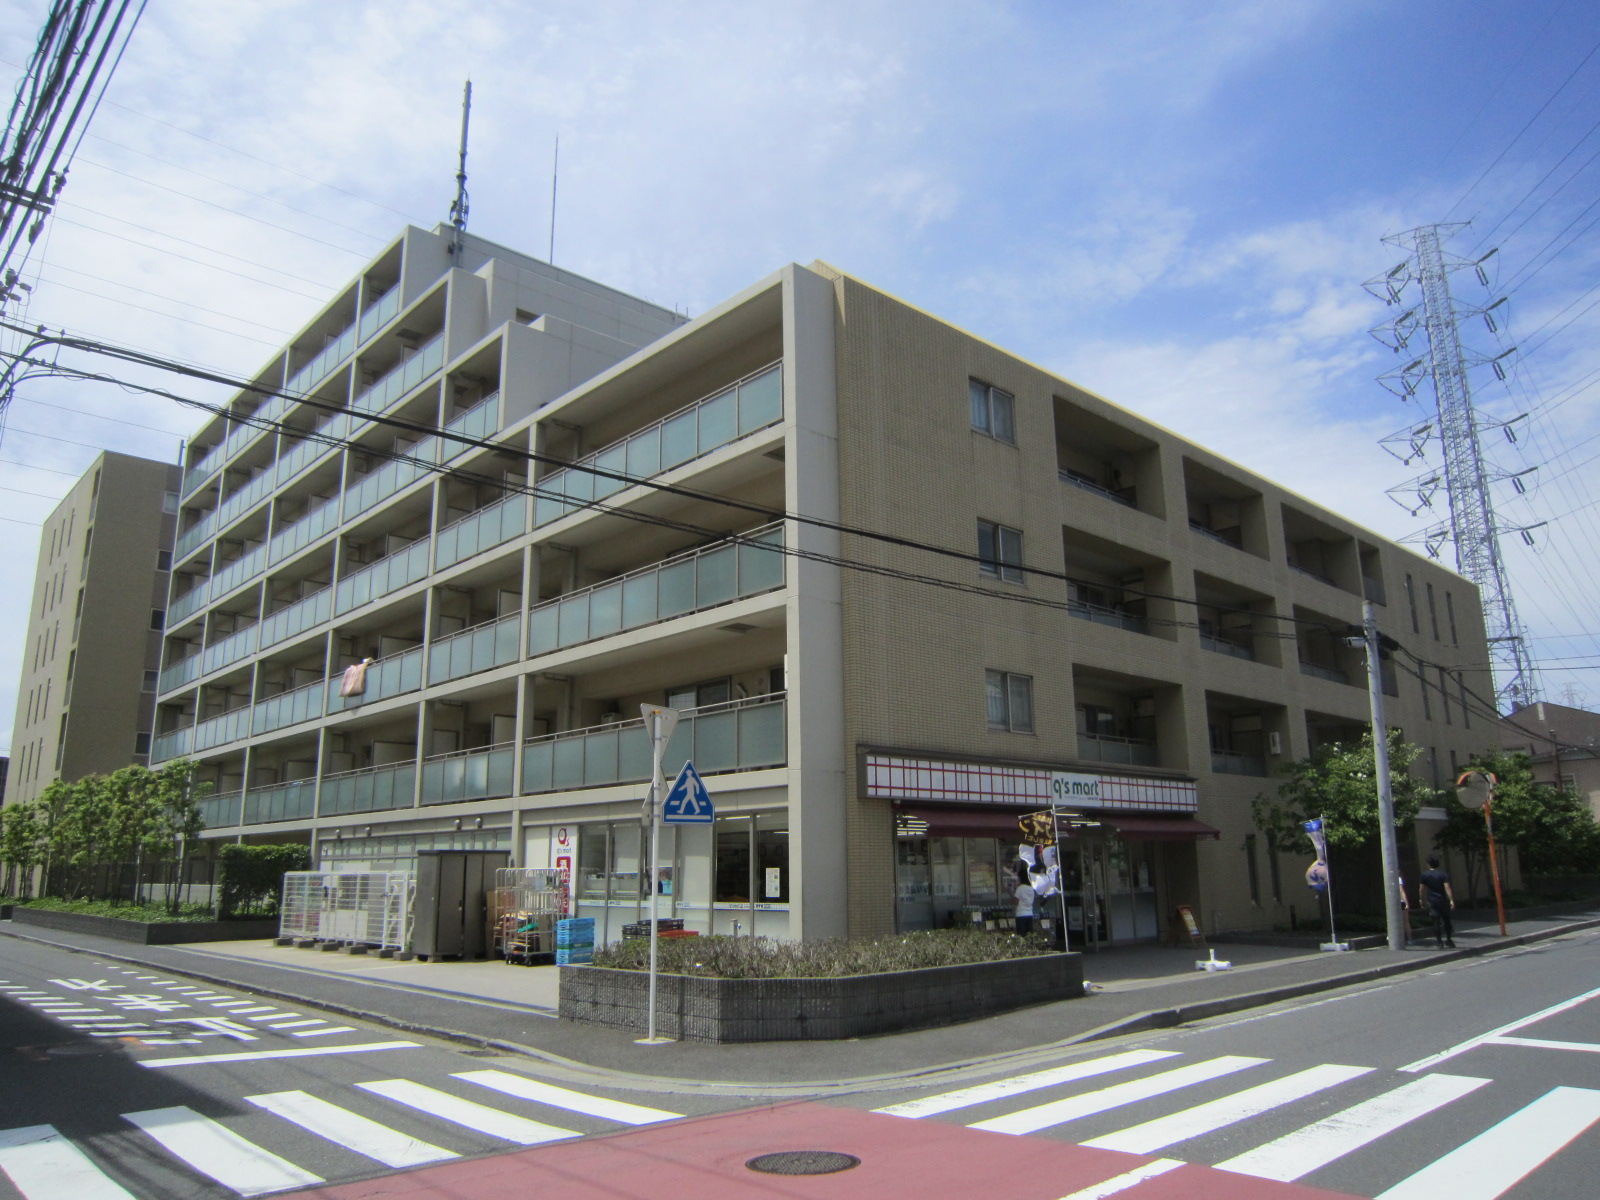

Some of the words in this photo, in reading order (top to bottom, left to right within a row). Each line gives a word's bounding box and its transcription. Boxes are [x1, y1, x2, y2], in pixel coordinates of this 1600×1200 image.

[1053, 778, 1070, 799] q's
[1072, 780, 1099, 796] mart
[47, 978, 260, 1041] 止まれ
